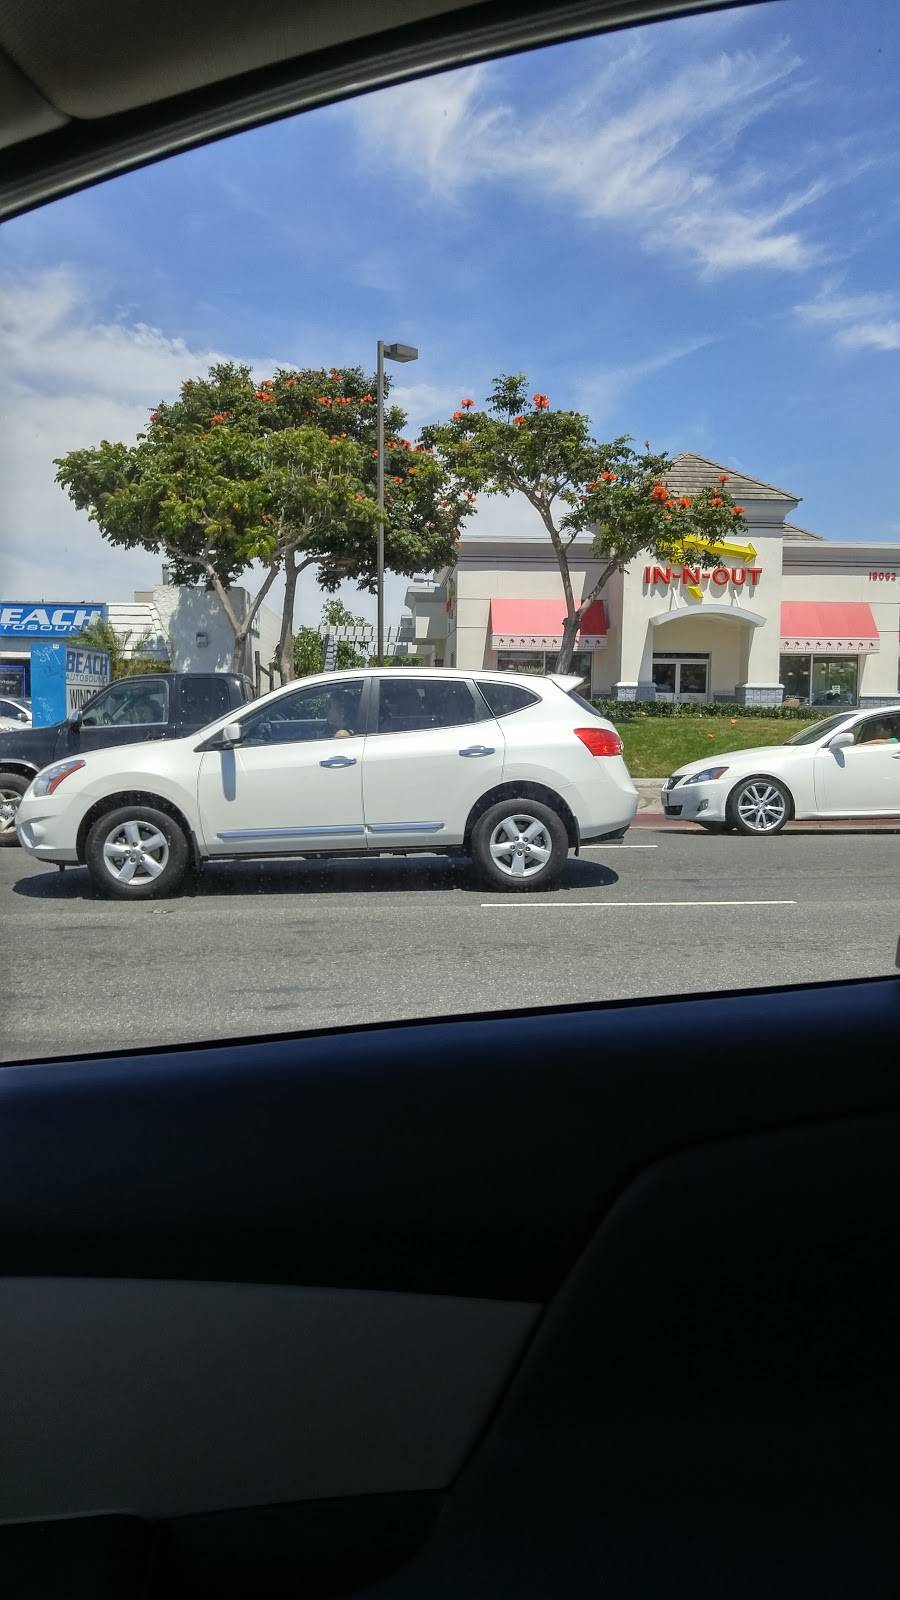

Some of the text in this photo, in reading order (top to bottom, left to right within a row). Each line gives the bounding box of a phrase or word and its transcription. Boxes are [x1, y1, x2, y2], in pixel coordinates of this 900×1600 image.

[645, 566, 762, 585] IN-N-OUT
[0, 608, 101, 626] EACH
[0, 624, 89, 632] TOSOUN
[66, 651, 108, 675] BEACH
